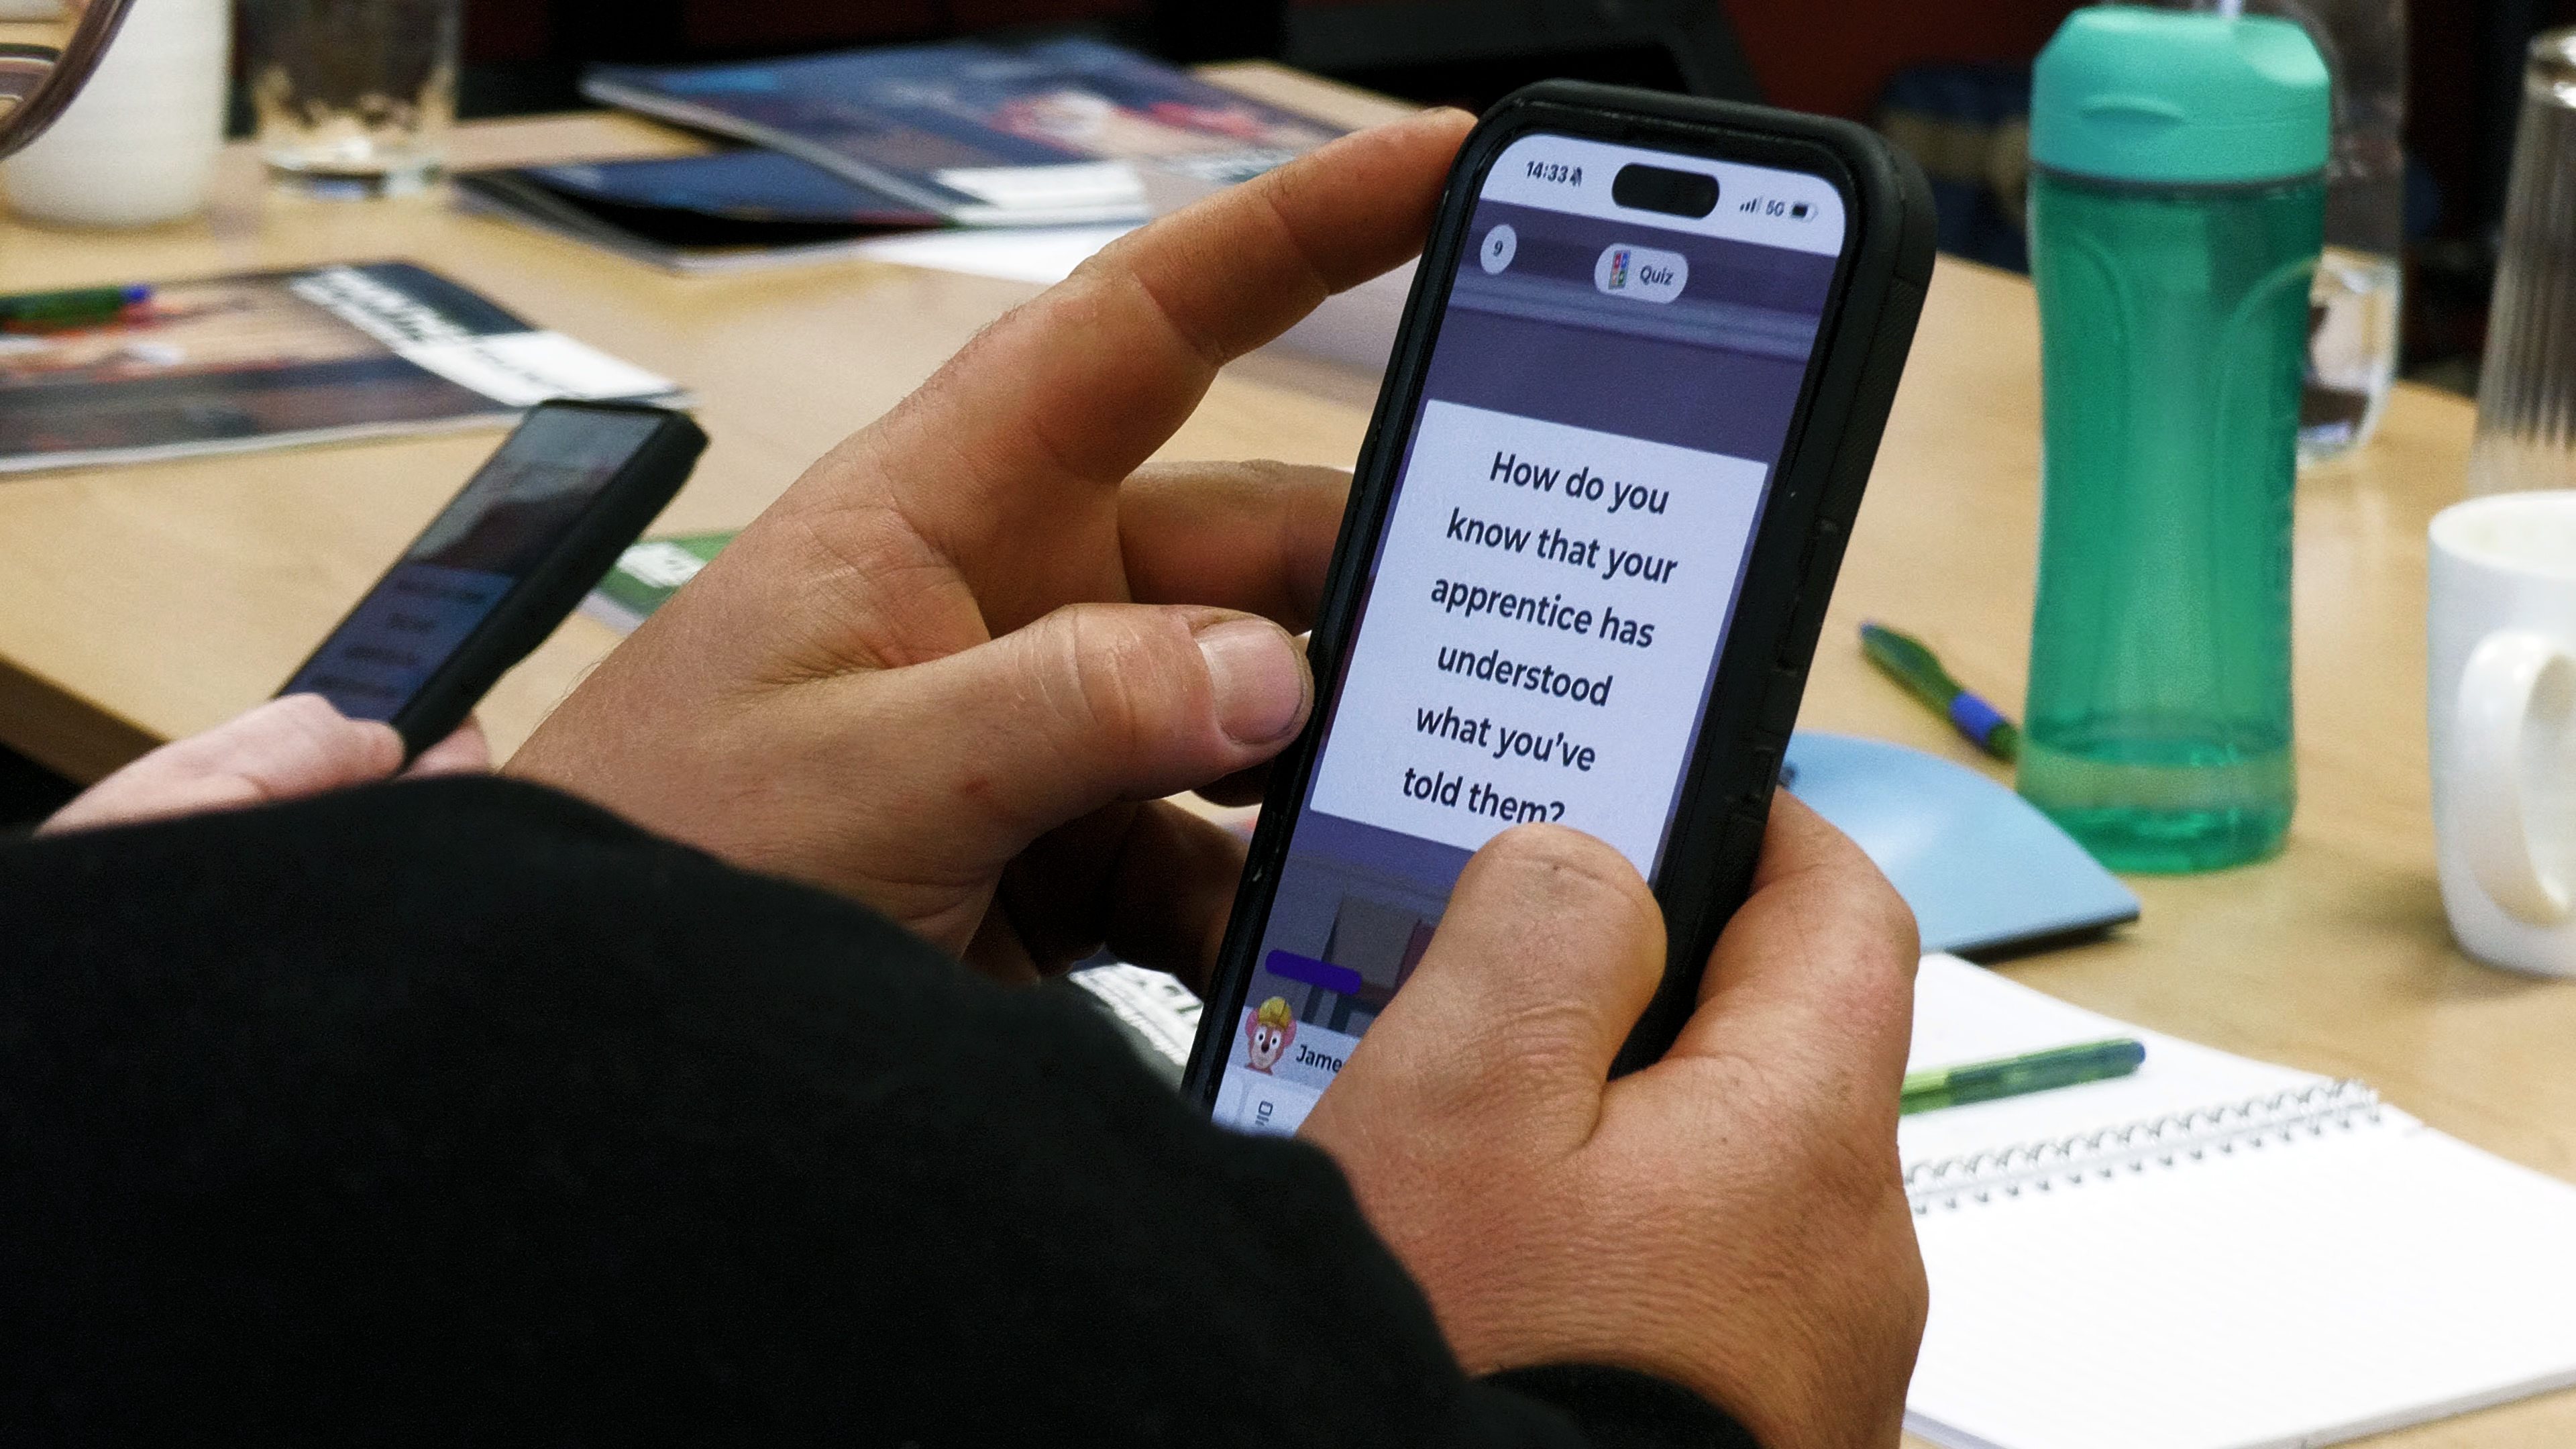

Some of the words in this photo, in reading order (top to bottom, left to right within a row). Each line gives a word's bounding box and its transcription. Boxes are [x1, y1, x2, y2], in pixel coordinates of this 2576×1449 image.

[1527, 160, 1569, 183] 14:33
[1766, 200, 1785, 217] 5G
[1493, 240, 1504, 257] 9
[1640, 265, 1674, 286] Quiz
[1490, 451, 1561, 492] How
[1565, 466, 1605, 501] do
[1607, 481, 1670, 515] you
[1446, 506, 1532, 553] know
[1537, 527, 1601, 569] that
[1601, 548, 1678, 584] your
[1431, 578, 1593, 635] apprentice
[1599, 606, 1655, 648] has
[1438, 646, 1613, 707] understood
[1417, 706, 1492, 748] what
[1492, 727, 1595, 772] you've
[1403, 767, 1464, 808] told
[1468, 782, 1565, 824] them?
